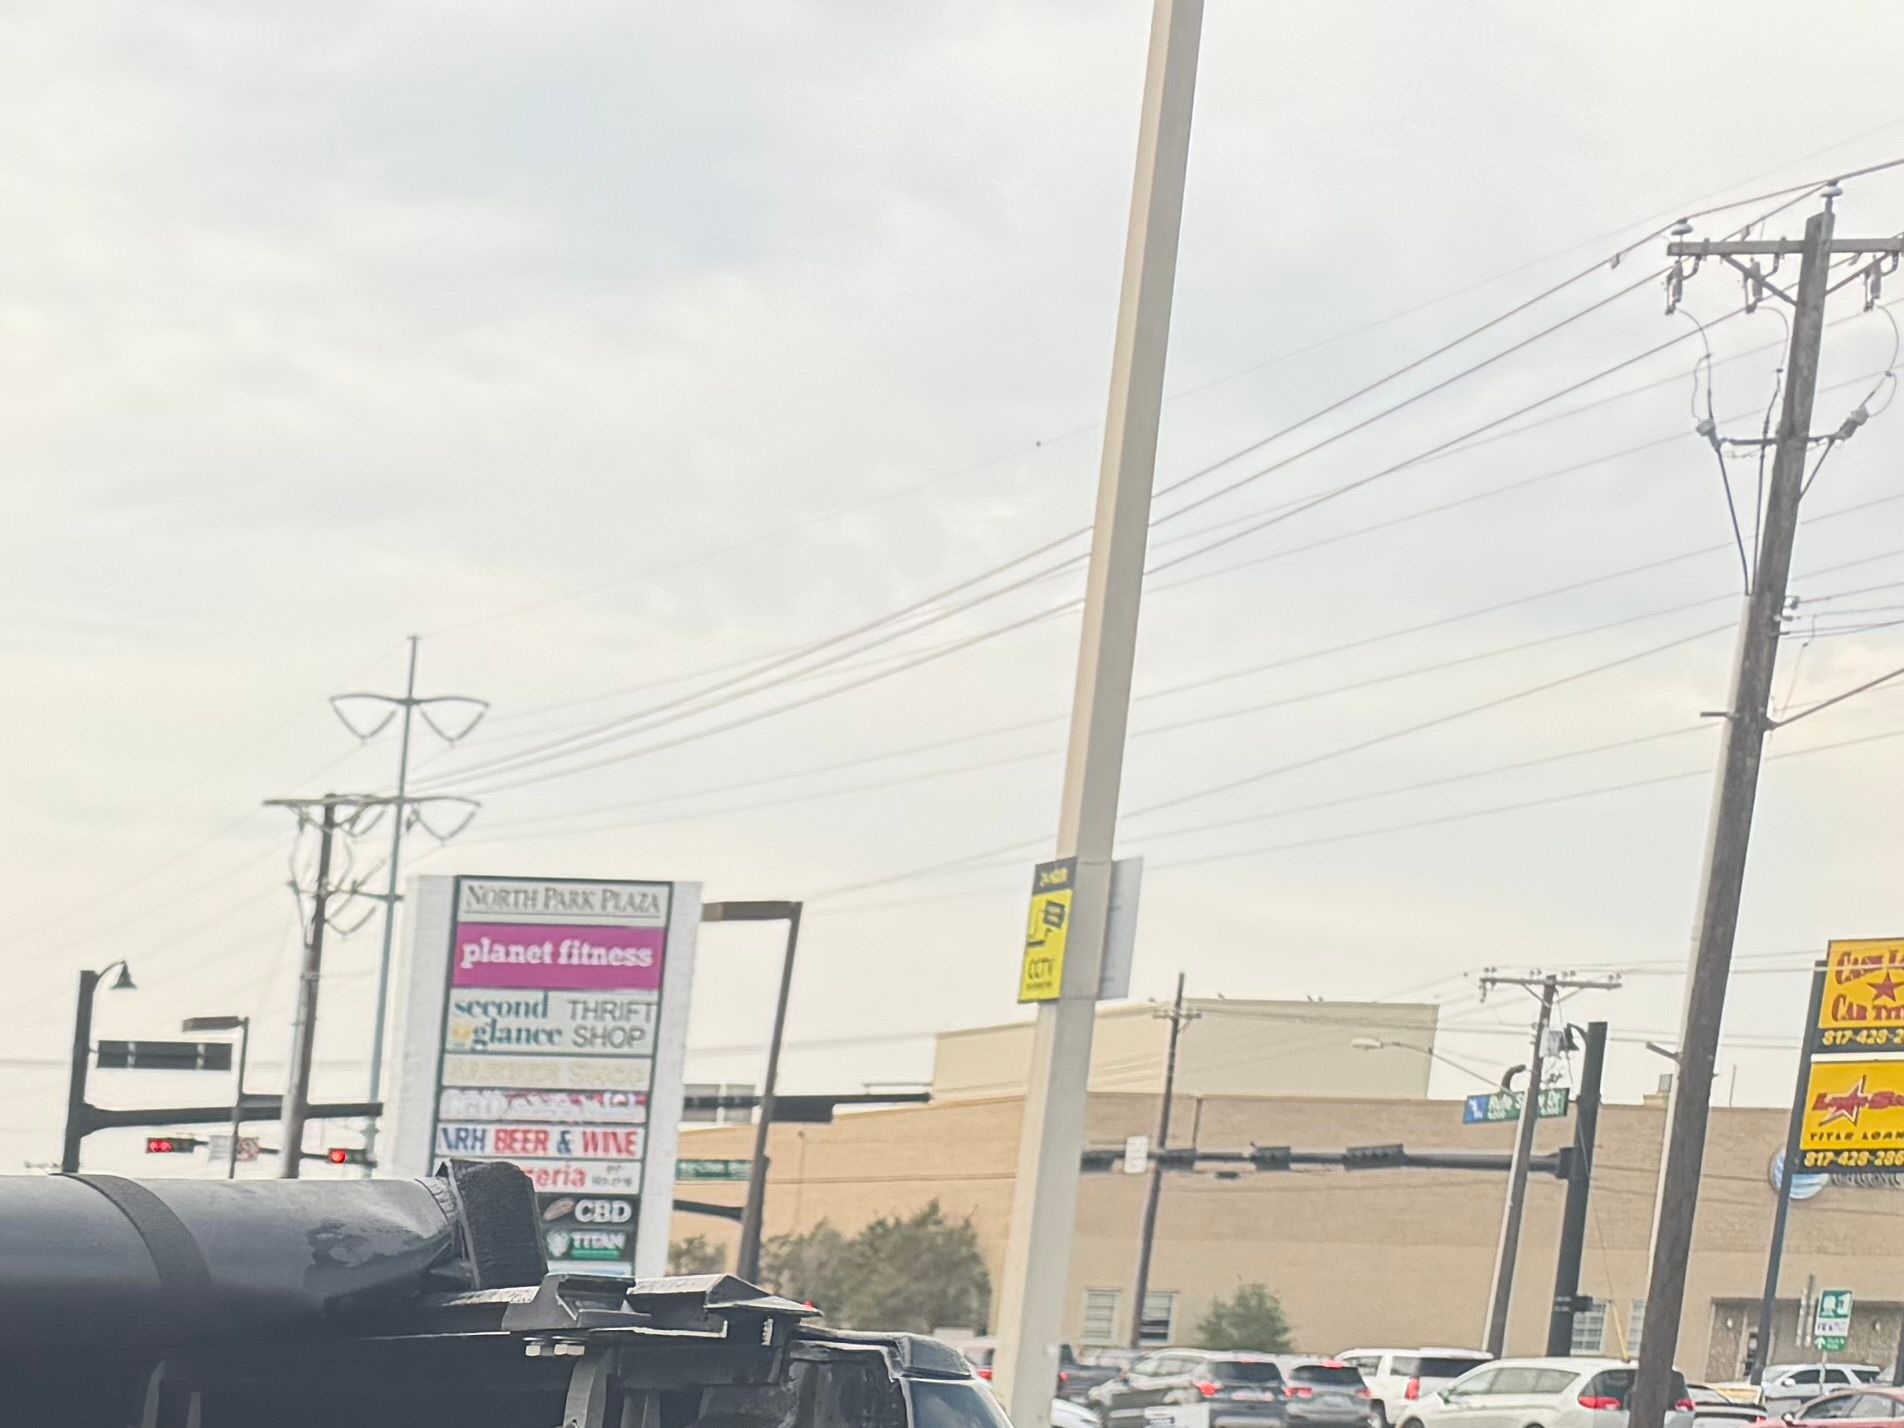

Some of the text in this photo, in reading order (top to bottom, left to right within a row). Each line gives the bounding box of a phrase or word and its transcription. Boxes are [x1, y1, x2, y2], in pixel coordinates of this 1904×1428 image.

[460, 936, 653, 969] planet fitness
[454, 991, 659, 1023] second THRIFT
[470, 1018, 646, 1052] glance SHOP
[494, 1129, 549, 1154] BEER
[556, 1130, 572, 1155] &
[582, 1130, 638, 1156] WINE
[575, 1199, 632, 1223] CBD
